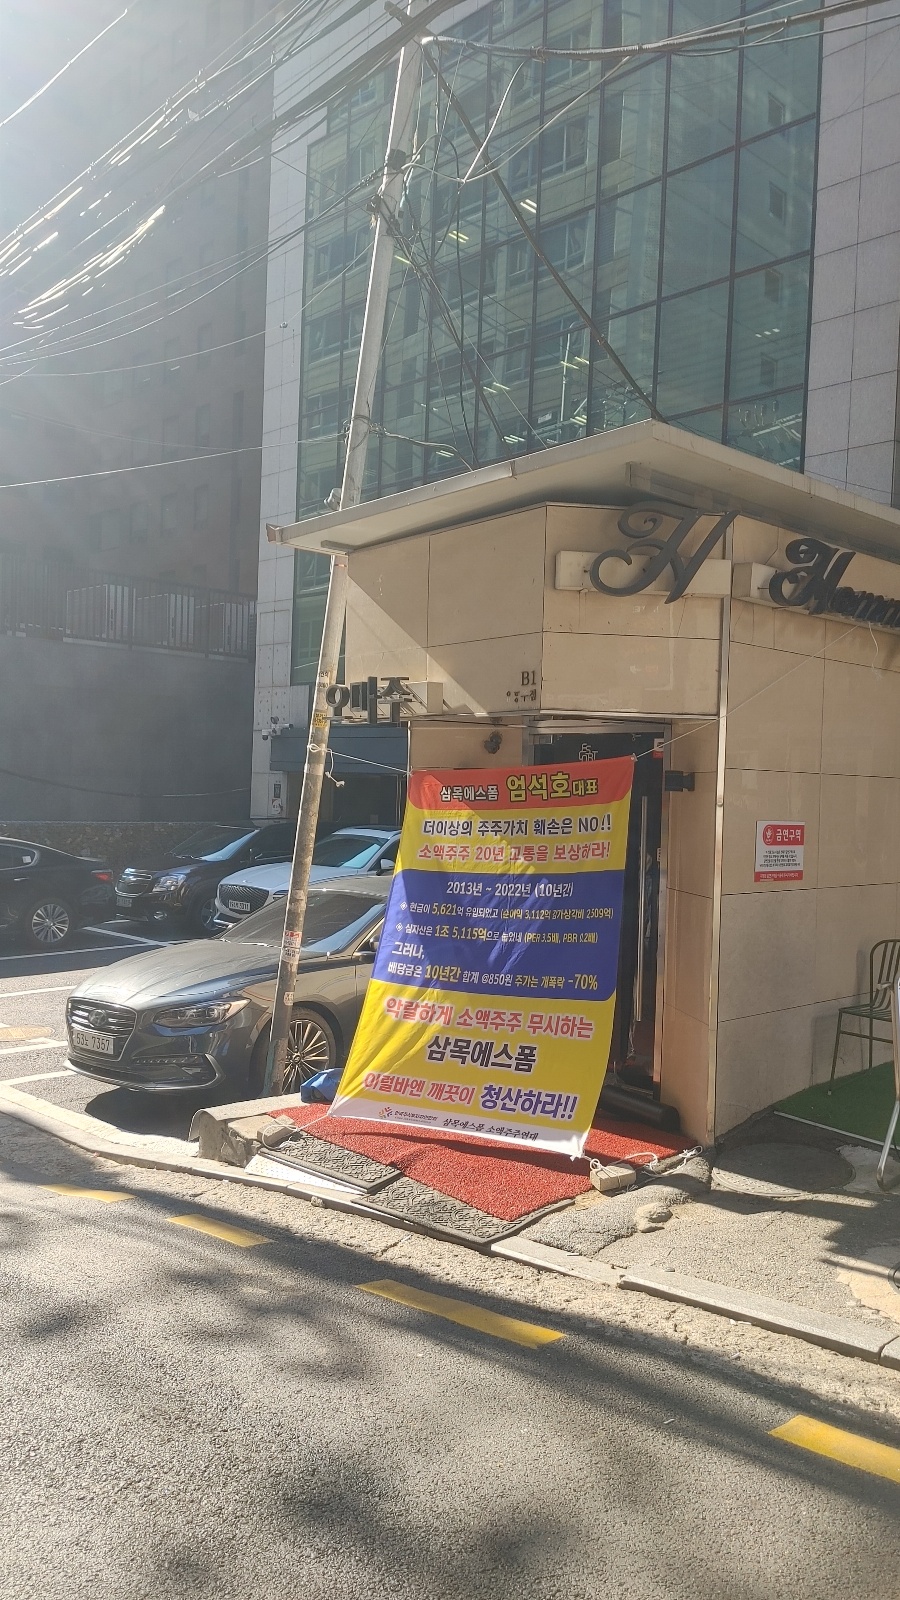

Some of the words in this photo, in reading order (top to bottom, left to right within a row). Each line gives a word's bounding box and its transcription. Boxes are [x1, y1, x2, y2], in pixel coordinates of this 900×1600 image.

[521, 670, 537, 686] B1
[440, 785, 499, 802] 삼목에스폼
[506, 772, 571, 802] 엄석호
[571, 778, 599, 797] 대표
[423, 819, 472, 837] 더이상의
[477, 818, 528, 836] 주주가치
[533, 817, 573, 835] 훼손은
[578, 814, 612, 832] NO!!
[775, 828, 801, 842] 금연구역
[419, 844, 470, 862] 소액주주
[476, 846, 505, 862] 20년
[509, 844, 549, 862] 고통을
[554, 842, 611, 861] 보상하라!
[446, 881, 483, 897] 2013년
[494, 882, 532, 898] 2022년
[534, 882, 574, 898] (10년간)
[409, 902, 430, 914] 현금이
[431, 902, 464, 917] 5,621억
[465, 906, 499, 918] 유입되었고
[434, 924, 450, 938] 1조
[451, 926, 500, 941] 5,115억으로
[563, 933, 578, 943] PBR
[391, 941, 425, 959] 그러나,
[387, 961, 423, 978] 배당금은
[424, 964, 461, 983] 10년간
[462, 970, 479, 984] 합계
[514, 974, 539, 988] 주가는
[540, 975, 566, 989] 개폭락
[568, 973, 598, 991] -70%
[385, 997, 453, 1027] 악랄하게
[456, 1007, 522, 1033] 소액주주
[527, 1013, 595, 1039] 무시하는
[92, 1035, 110, 1051] 7357
[427, 1034, 537, 1073] 삼목에스폼
[364, 1071, 425, 1098] 이럴바엔
[427, 1081, 476, 1105] 깨끗이
[480, 1083, 578, 1120] 청산하라!!
[443, 1118, 485, 1132] 삼목에스폼
[485, 1125, 539, 1141] 소액주주연대
